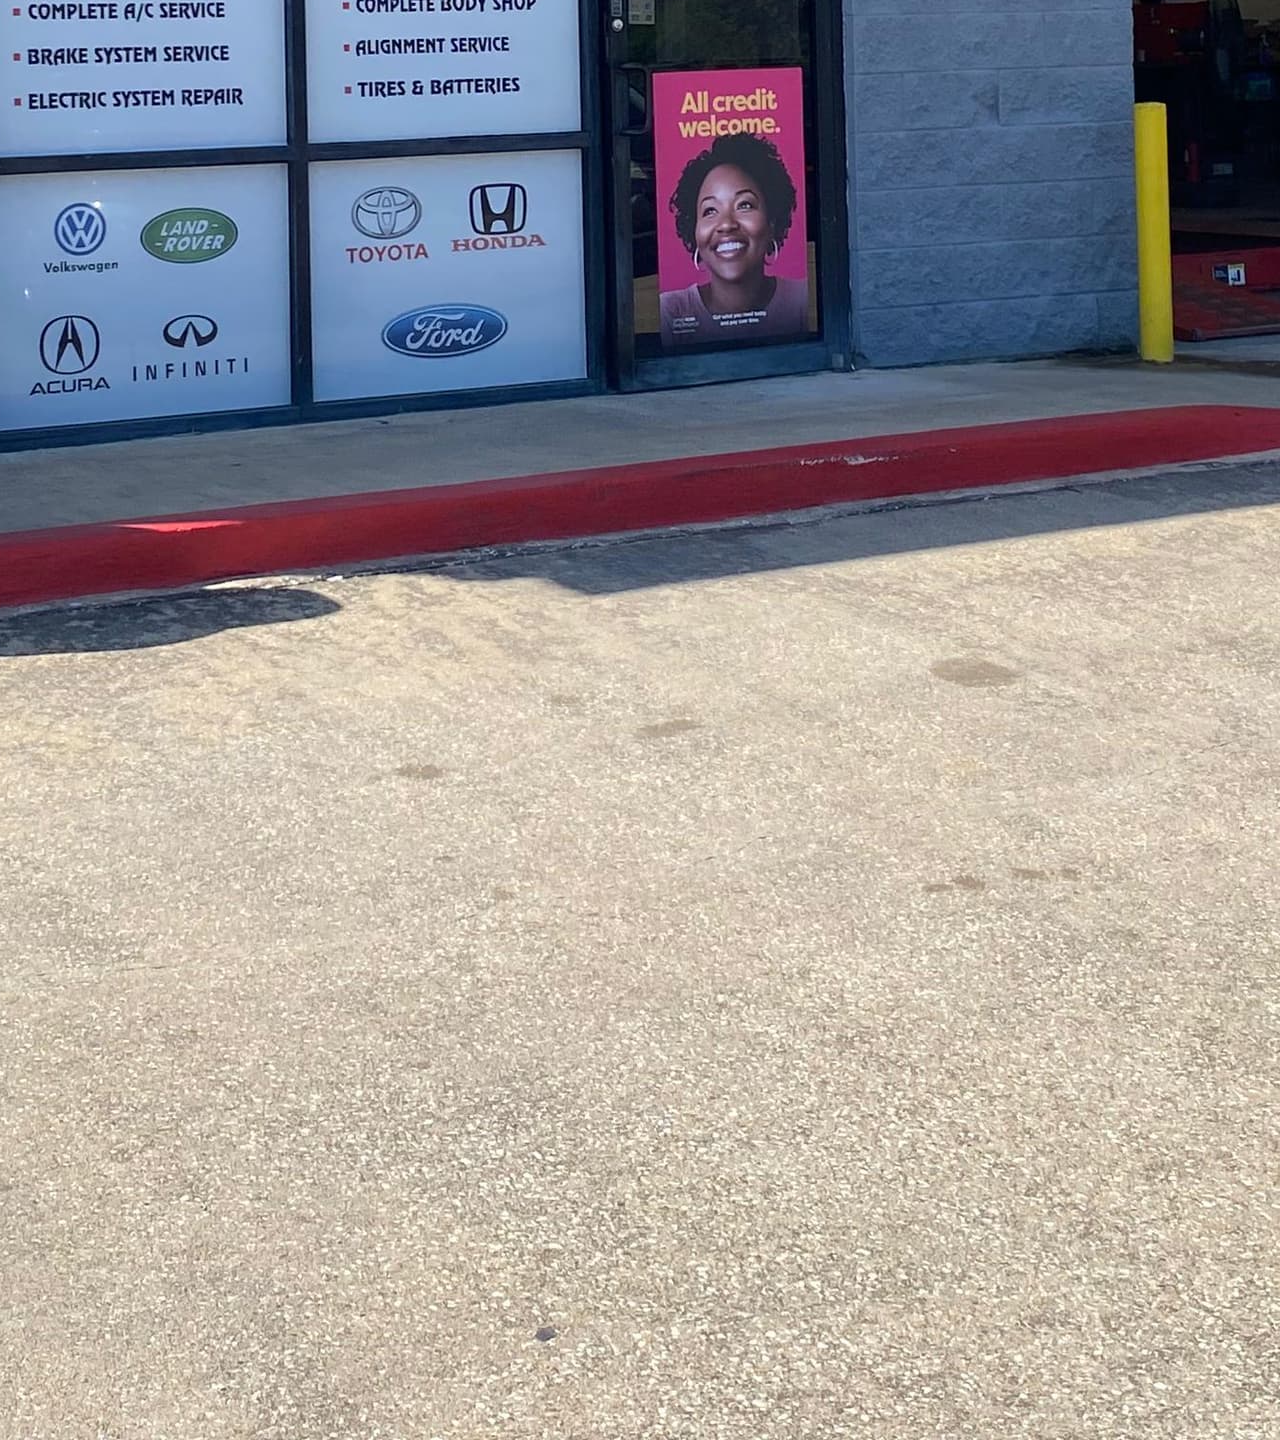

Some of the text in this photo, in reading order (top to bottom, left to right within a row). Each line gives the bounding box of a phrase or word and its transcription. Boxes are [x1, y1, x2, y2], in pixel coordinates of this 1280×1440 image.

[28, 2, 225, 22] COMPLETE A/C SERVICE
[27, 45, 230, 65] BRAKE SYSTEM SERVICE
[355, 37, 509, 56] ALIGNMENT SERVICE
[357, 77, 520, 98] TIRES & BATTERIES
[28, 88, 244, 109] ELECTRIC SYSTEM REPAIR
[681, 88, 778, 114] All credit
[678, 114, 781, 138] welcome.
[346, 243, 429, 264] TOYOTA
[451, 234, 546, 252] HONDA
[43, 261, 118, 273] Volkswagen
[405, 312, 485, 350] Ford
[132, 357, 249, 382] INFINITI
[29, 376, 111, 396] ACURA
